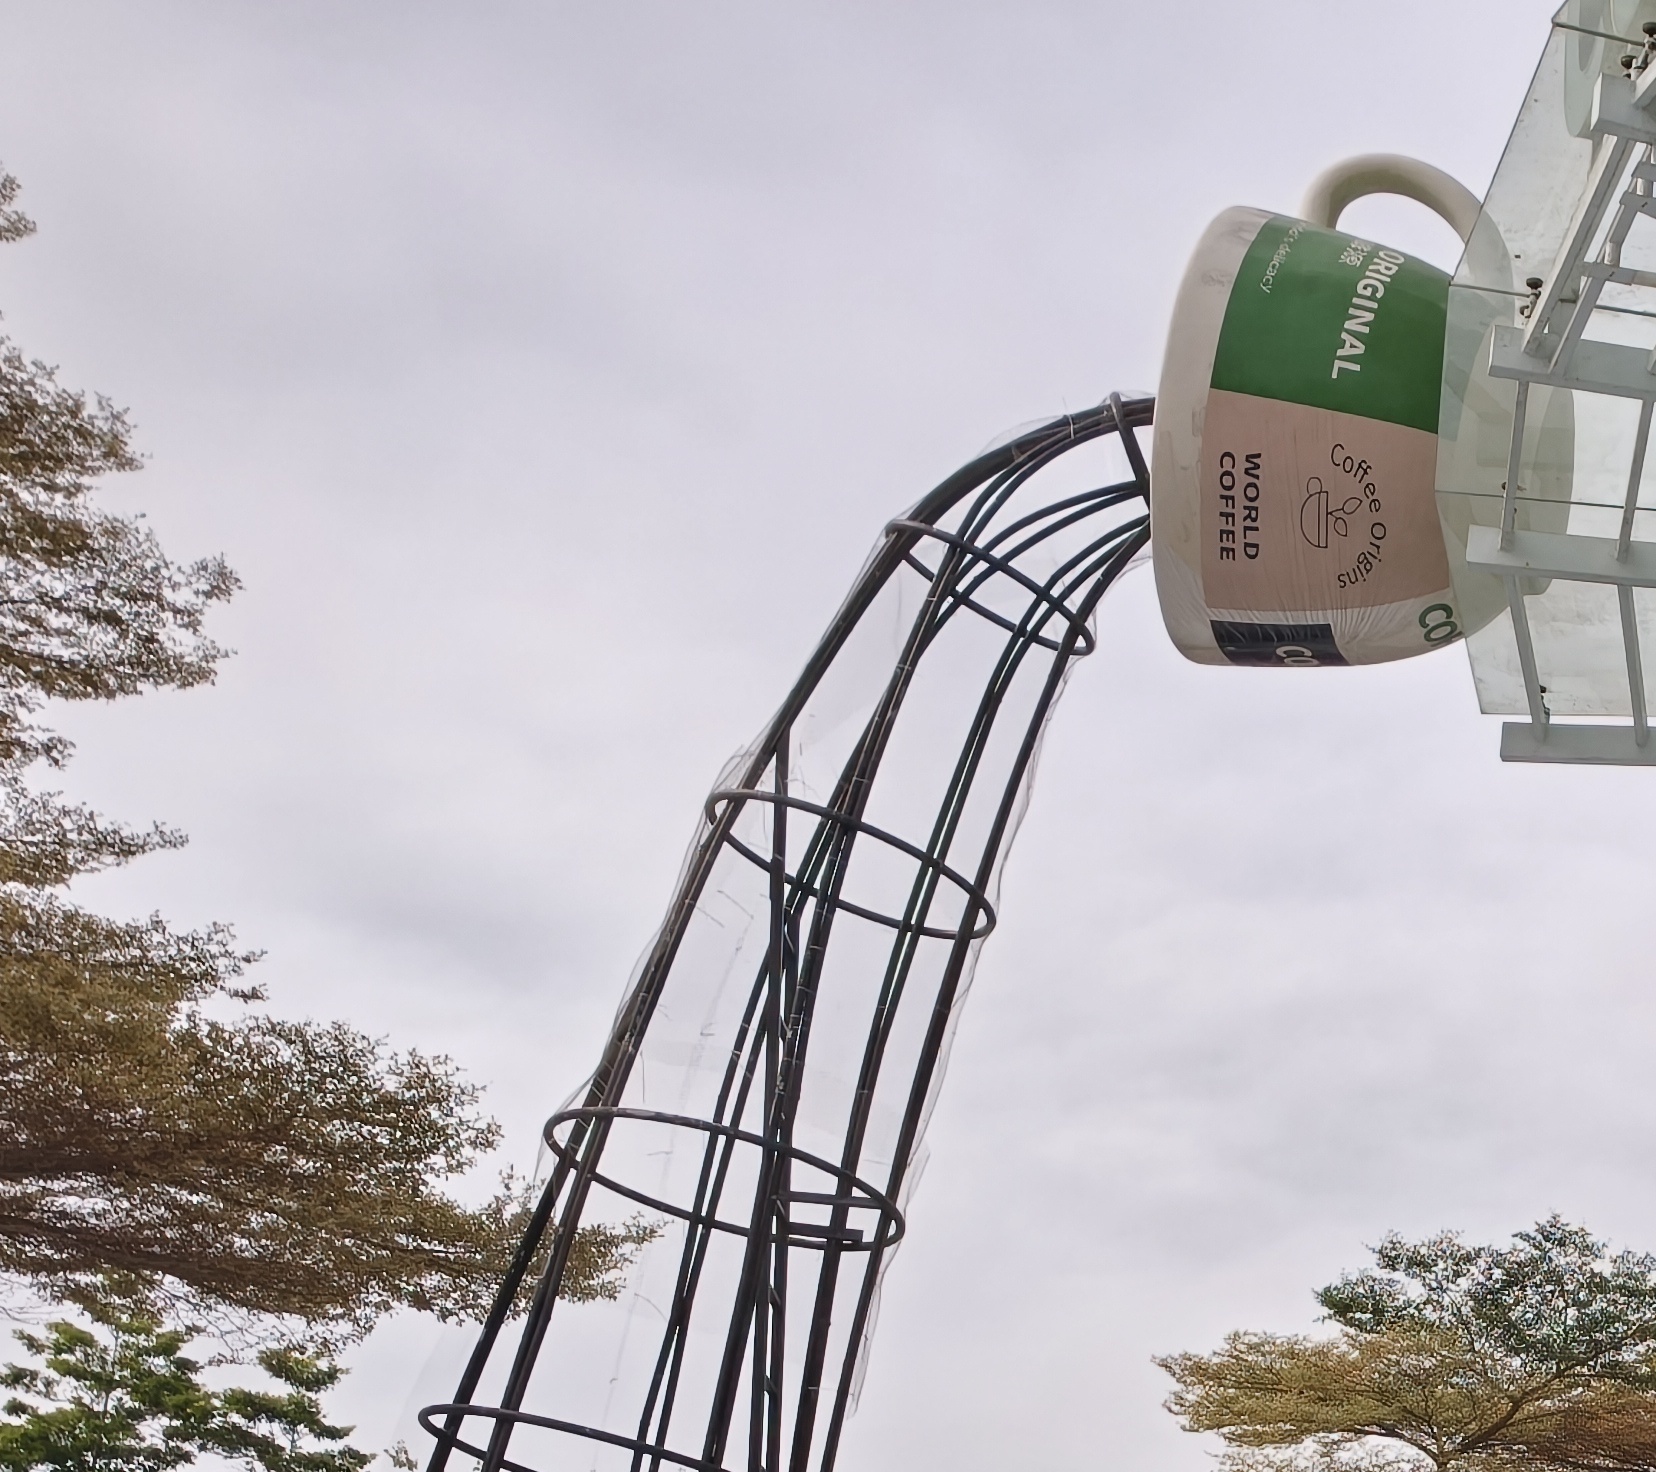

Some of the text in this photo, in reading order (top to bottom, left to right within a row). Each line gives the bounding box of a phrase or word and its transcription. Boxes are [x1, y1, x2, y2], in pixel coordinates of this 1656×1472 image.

[1260, 243, 1291, 294] delicacy
[1332, 250, 1405, 379] ORIGINAL
[1219, 450, 1236, 562] COFFEE
[1242, 451, 1262, 560] WORLD
[1330, 443, 1387, 590] Coffee Origins
[1418, 603, 1465, 647] CO
